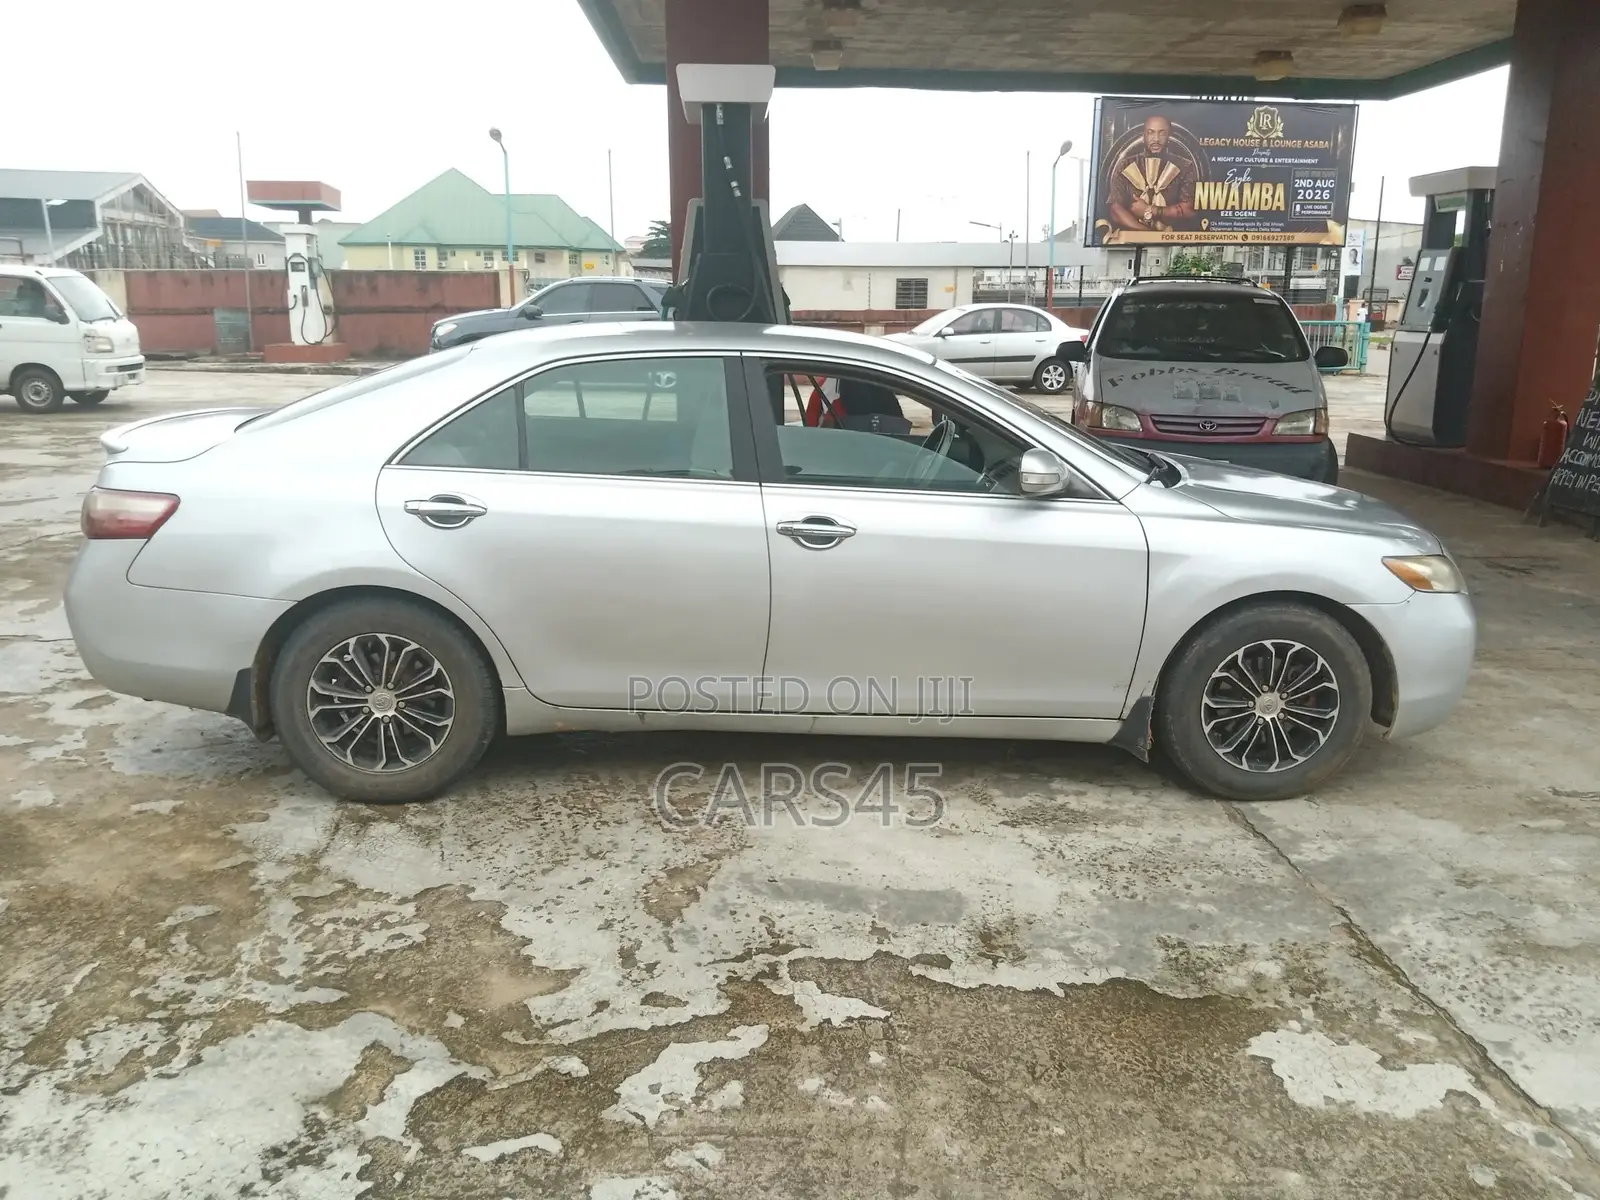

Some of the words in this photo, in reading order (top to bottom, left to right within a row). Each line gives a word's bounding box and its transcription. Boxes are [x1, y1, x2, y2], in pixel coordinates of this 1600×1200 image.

[1199, 137, 1231, 147] LEGACY
[1233, 138, 1261, 147] HOUSE
[1262, 139, 1269, 148] &
[1270, 139, 1303, 149] LOUNGE
[1304, 140, 1329, 149] ASABA
[1294, 179, 1314, 188] 2ND
[1315, 179, 1335, 188] AUG
[1194, 181, 1285, 211] NWAMBA
[1297, 189, 1330, 200] 2026
